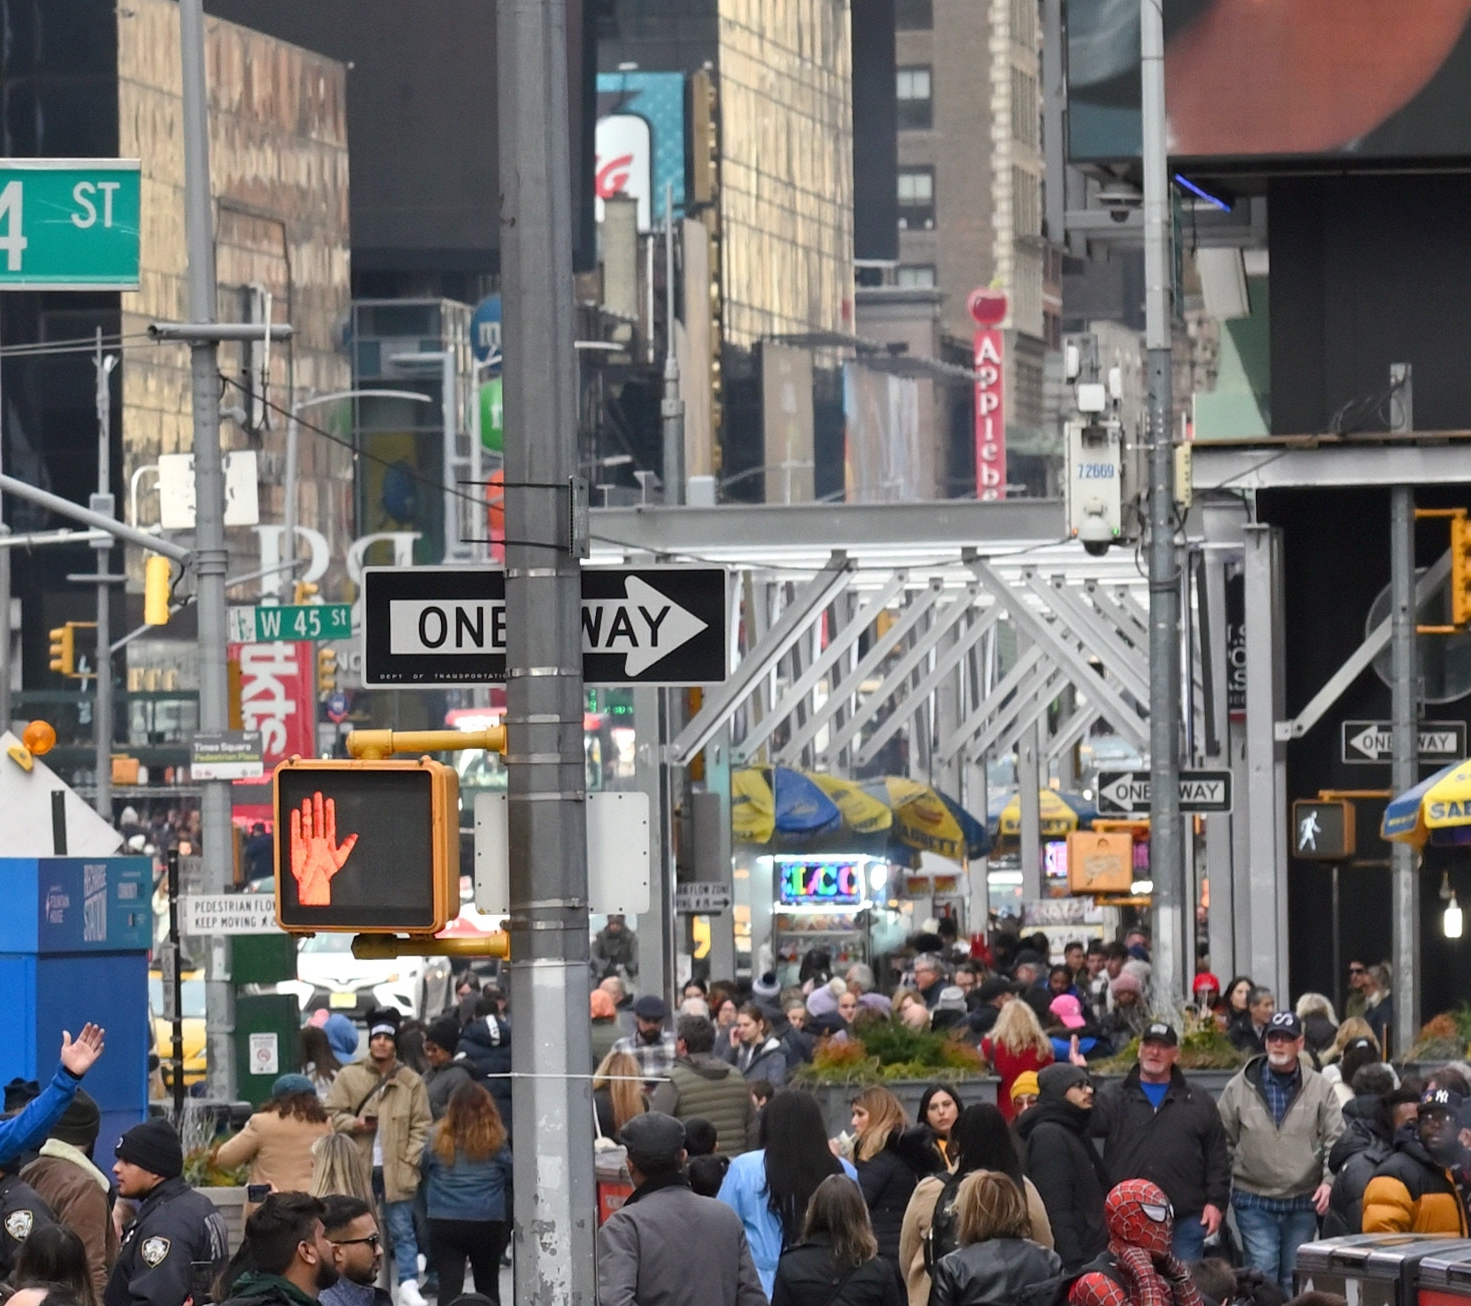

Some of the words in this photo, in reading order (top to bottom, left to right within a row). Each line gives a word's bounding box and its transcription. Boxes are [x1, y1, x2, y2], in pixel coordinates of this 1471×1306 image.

[71, 180, 121, 230] ST
[1078, 463, 1115, 481] 72669
[260, 611, 282, 638] W
[292, 609, 321, 637] 45
[331, 608, 347, 628] St
[417, 606, 507, 649] ONE
[379, 673, 403, 681] DEPT
[194, 742, 220, 753] Times
[222, 742, 252, 756] Square
[1116, 783, 1153, 801] ONE
[195, 900, 252, 914] PEDESTRIAN
[195, 916, 218, 929] KEEP
[220, 914, 257, 928] MOVING
